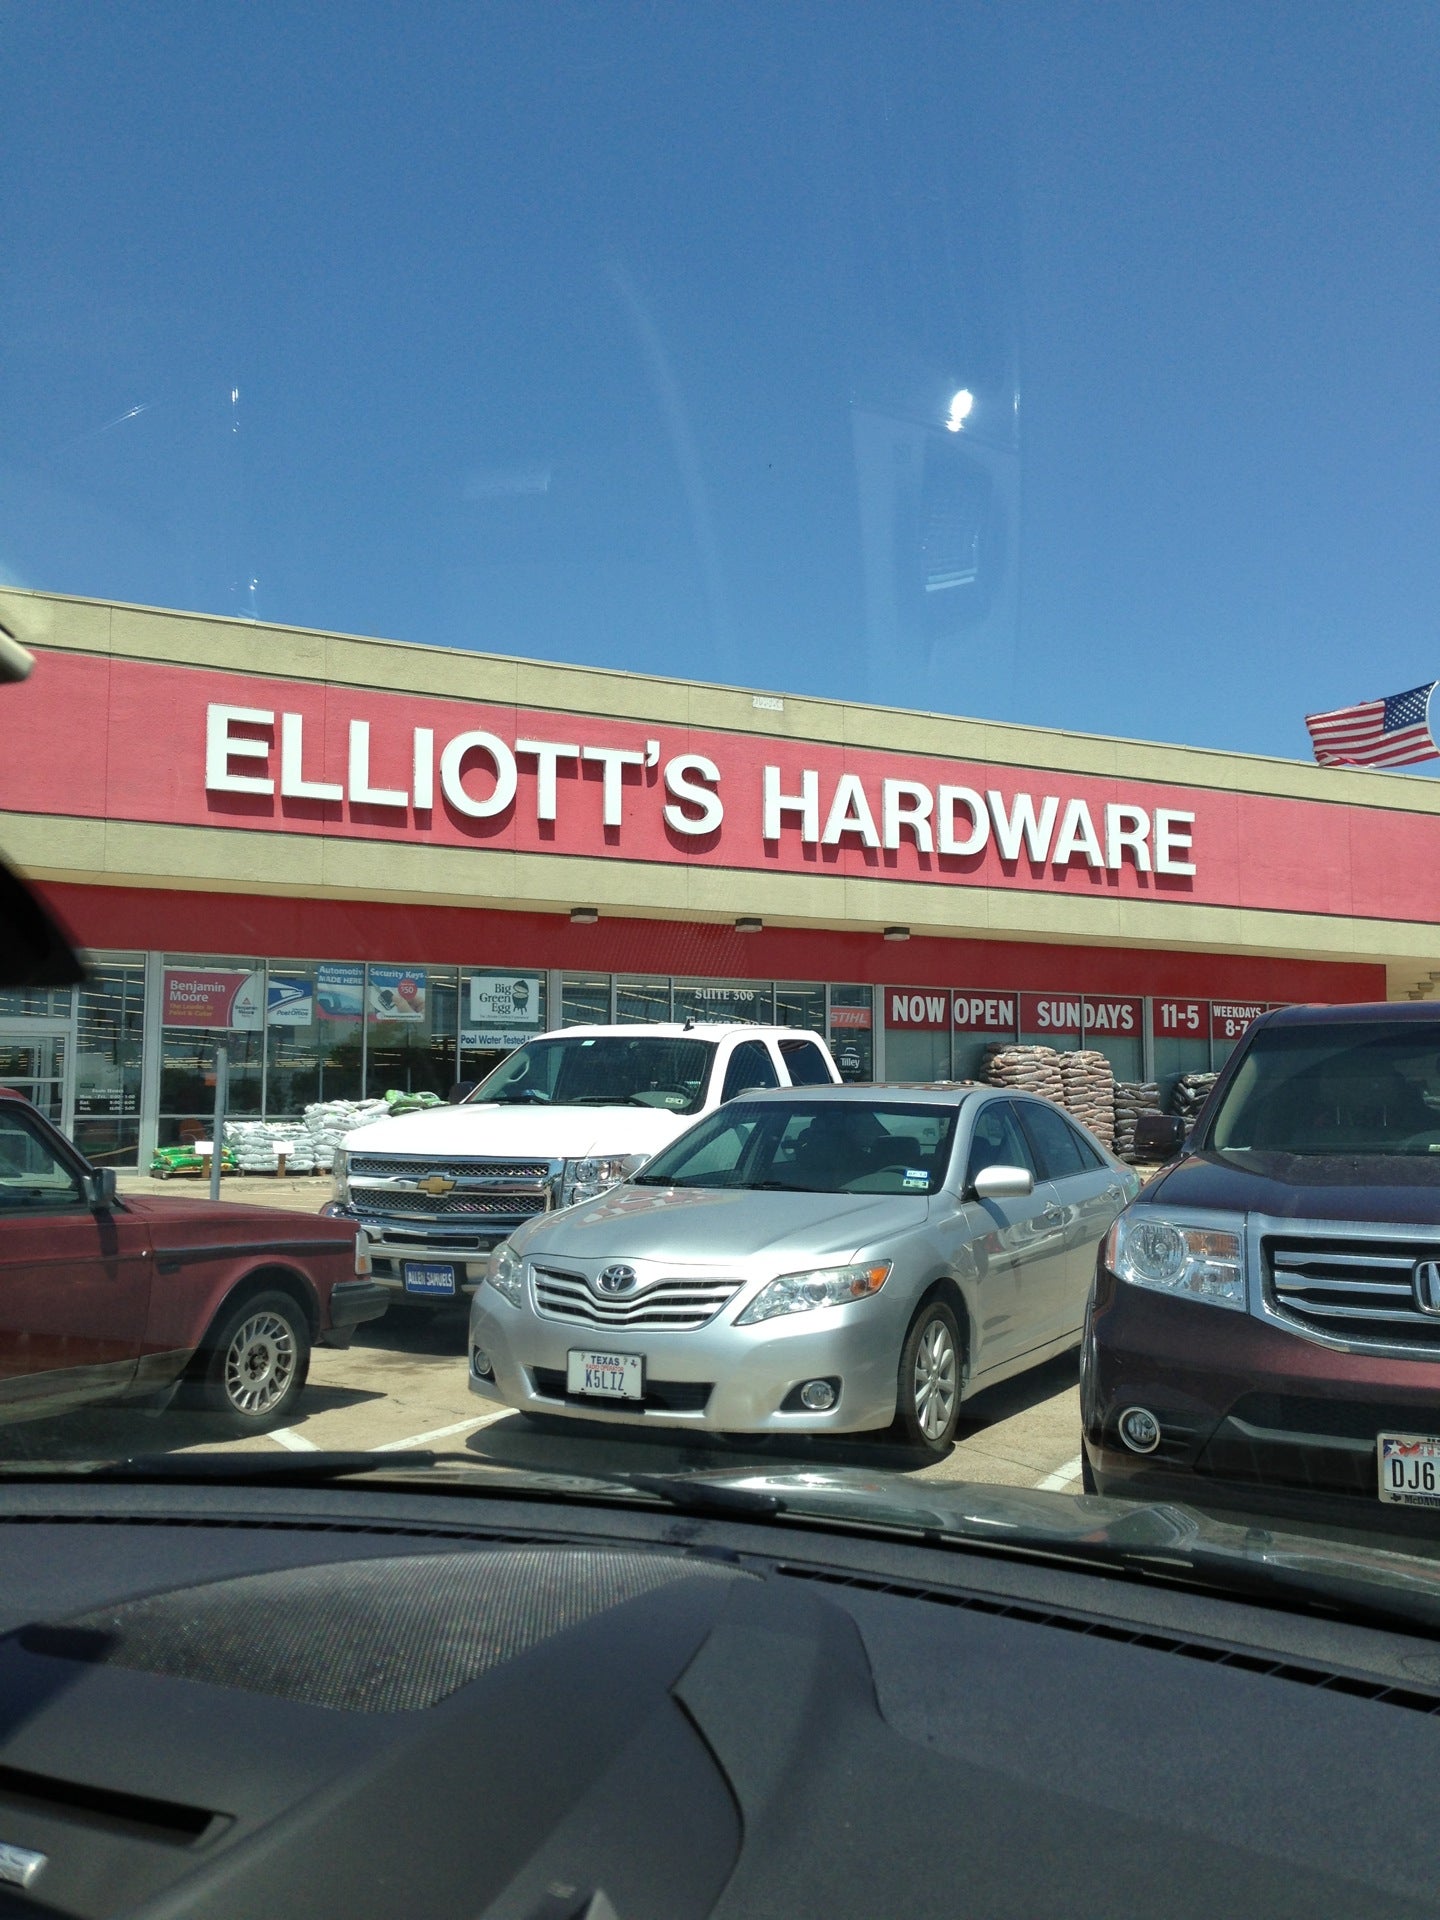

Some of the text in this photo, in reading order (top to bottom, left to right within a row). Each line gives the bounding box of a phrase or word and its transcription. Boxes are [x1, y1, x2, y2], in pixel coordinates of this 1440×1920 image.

[206, 703, 1197, 876] ELLIOTT'S HARDWARE
[319, 965, 365, 976] Automotiv
[369, 969, 425, 981] Security Keys
[319, 975, 363, 985] MADE HERE
[170, 980, 226, 994] Benjamin
[495, 984, 512, 996] Big
[169, 991, 209, 1002] Moore
[479, 993, 511, 1003] Green
[695, 989, 730, 1000] SUITE
[492, 1003, 511, 1015] Egg
[892, 995, 1200, 1030] NOW OPEN SUNDAYS 11-5
[1213, 1005, 1262, 1019] WEEKDAYS
[831, 1012, 868, 1025] STIHL
[461, 1034, 477, 1044] Pool
[478, 1035, 502, 1045] Water
[503, 1034, 526, 1045] Tested
[840, 1057, 860, 1069] Tilley
[591, 1355, 620, 1367] TEXAS
[585, 1369, 625, 1391] K5LIZ
[1391, 1458, 1435, 1491] DJ6
